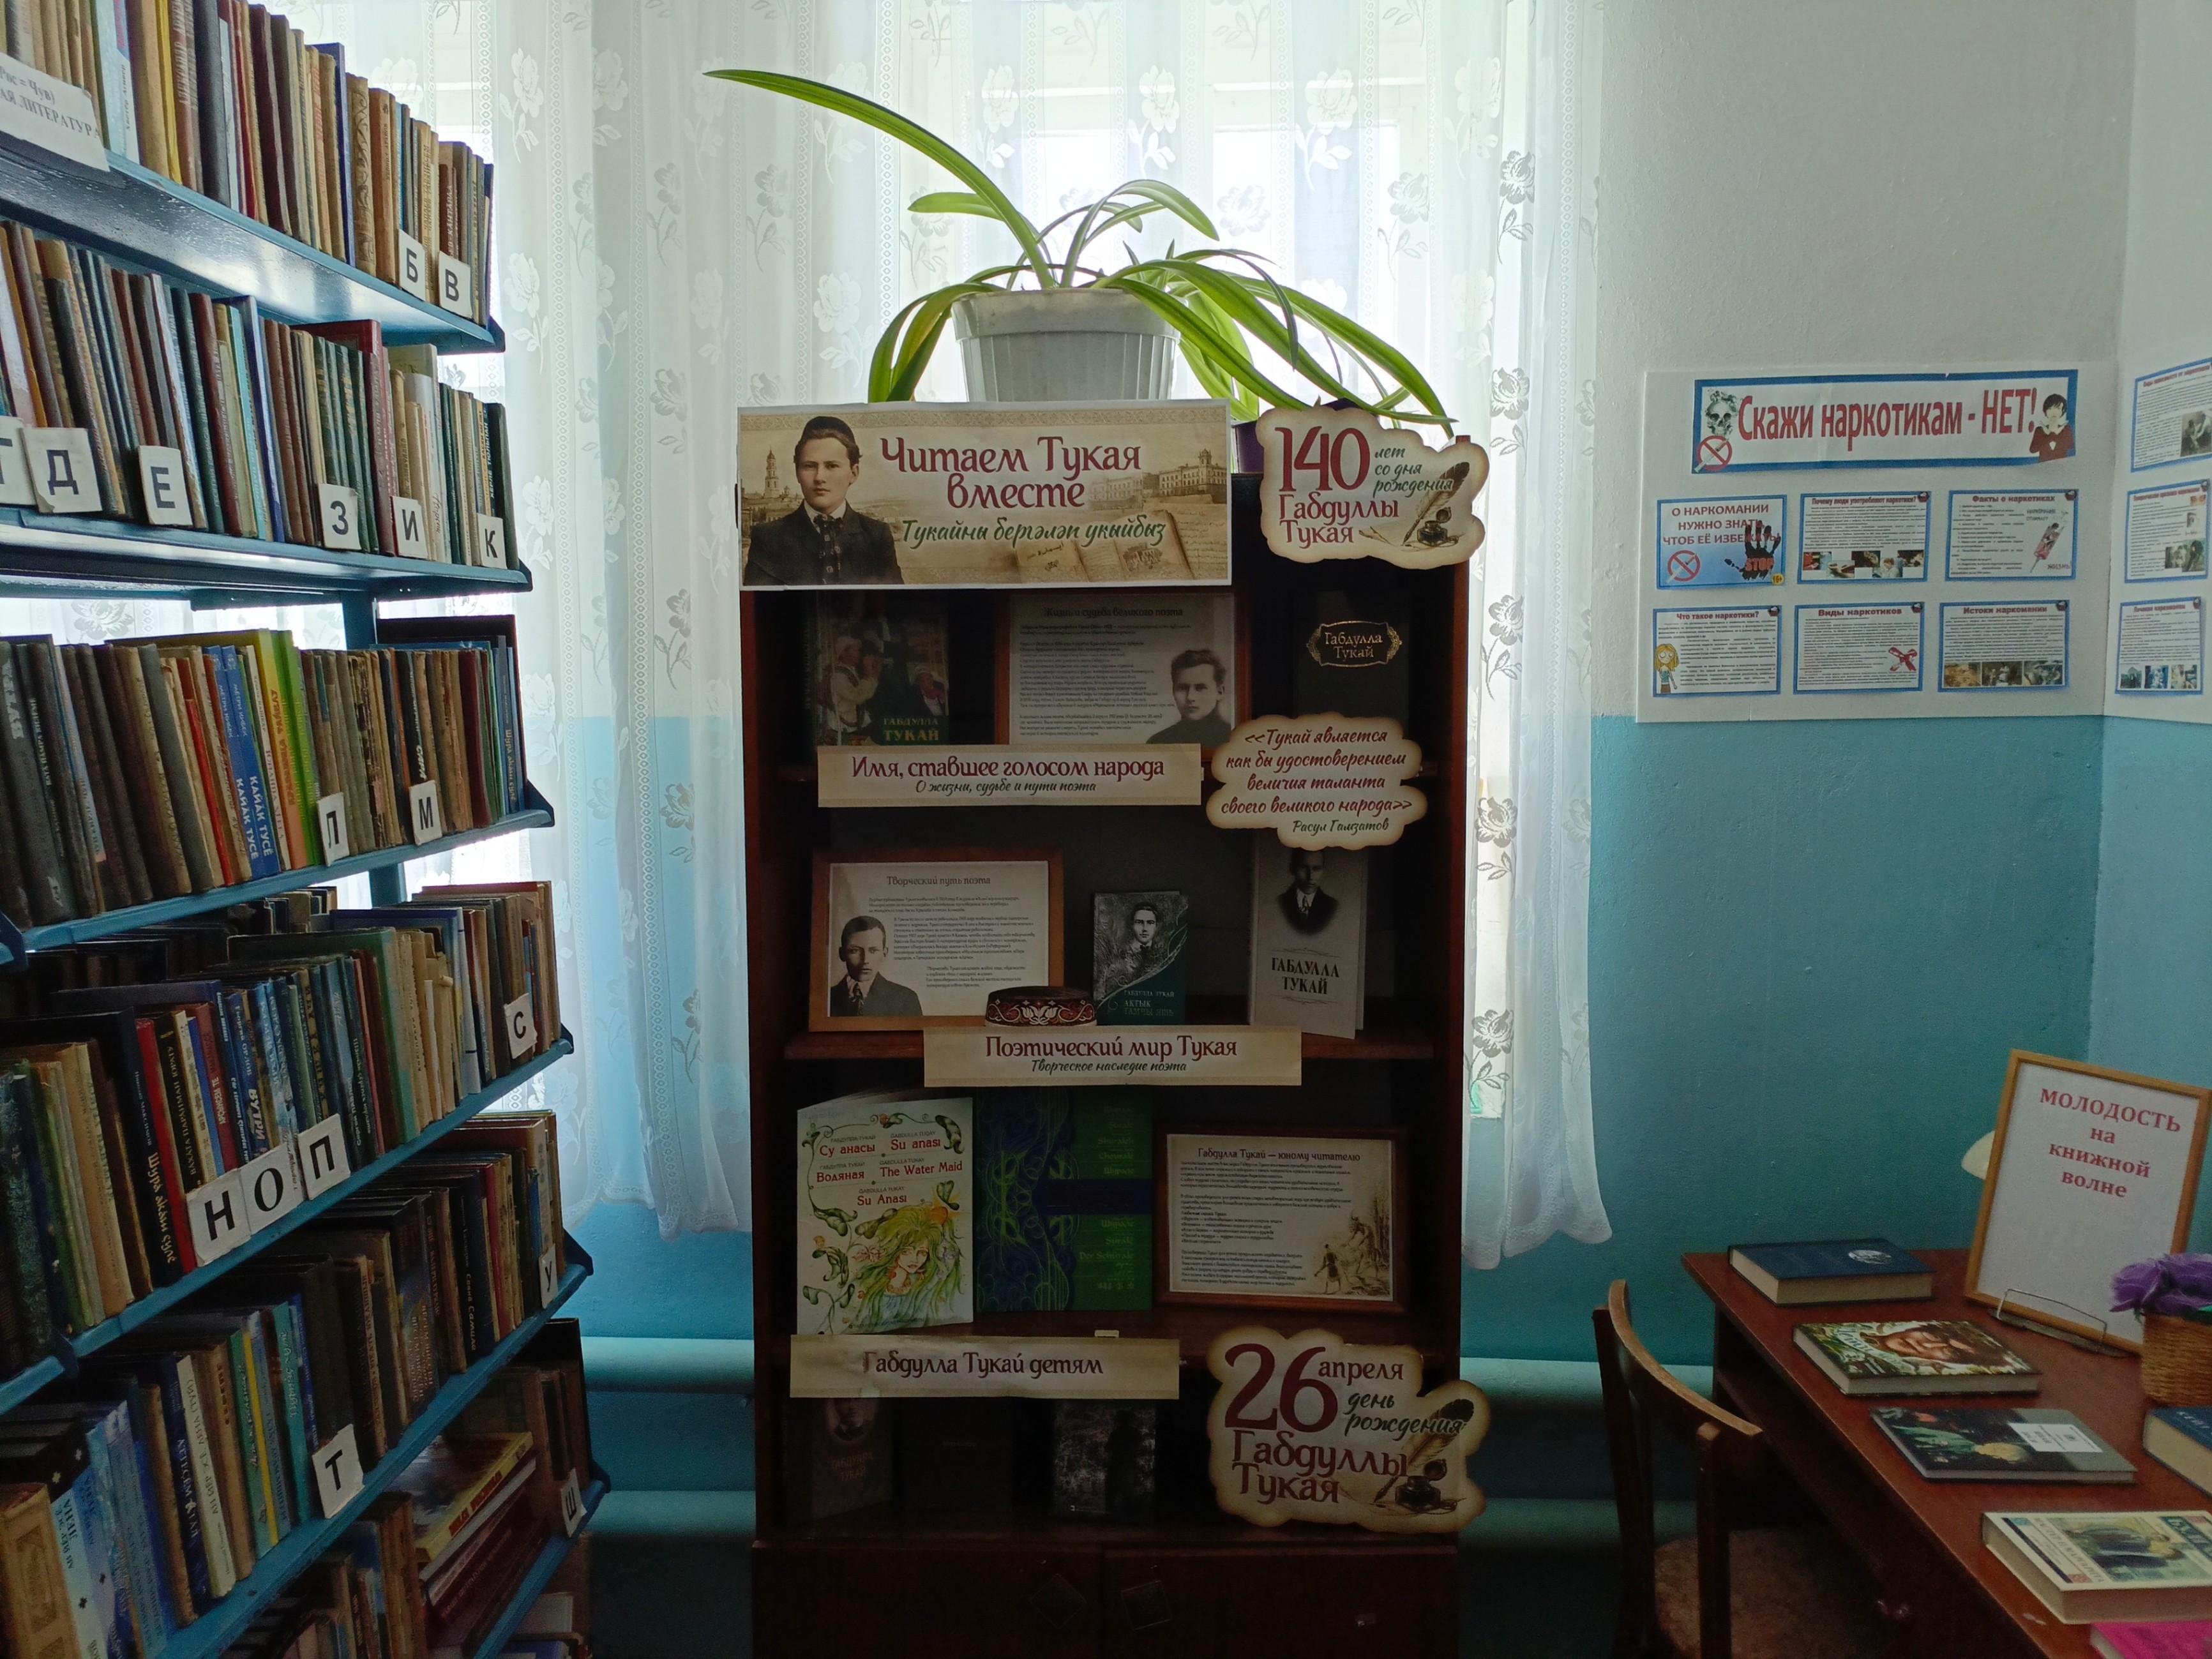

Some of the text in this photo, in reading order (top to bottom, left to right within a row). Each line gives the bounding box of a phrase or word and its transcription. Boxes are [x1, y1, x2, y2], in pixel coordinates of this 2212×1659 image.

[20, 96, 103, 139] ЛИТЕРАТУРА
[406, 248, 419, 282] Б
[446, 269, 458, 302] В
[1738, 394, 1813, 441] Скажи
[1821, 400, 1962, 451] наркотикам
[1982, 387, 2037, 434] НЕТ!
[484, 422, 492, 466] ТЮЛЬПАН
[1374, 447, 1406, 459] лет
[880, 436, 1141, 481] Читаем Тукая
[1275, 426, 1371, 492] 140
[1375, 463, 1422, 480] со дня
[47, 449, 79, 495] Д
[150, 465, 176, 509] Е
[947, 473, 1085, 509] вместе
[1373, 479, 1454, 499] рождения
[2008, 495, 2055, 504] наркотиках
[330, 500, 349, 534] З
[1279, 492, 1400, 525] Габдуллы
[1671, 504, 1769, 516] О НАРКОМАНИИ
[402, 509, 419, 542] И
[902, 520, 987, 550] Тукайны
[1085, 514, 1167, 547] укыйбыз
[1279, 519, 1354, 550] Тукая
[1678, 520, 1721, 530] НУЖНО
[485, 529, 498, 558] К
[1664, 535, 1694, 546] ЧТОБ
[1698, 533, 1711, 544] ЕЁ
[1745, 557, 1775, 571] STOP
[1772, 575, 1783, 583] 16+
[1082, 608, 1111, 619] судьба
[1113, 606, 1154, 617] великого
[1155, 608, 1183, 617] поэта
[1676, 613, 1690, 621] Что
[1715, 611, 1759, 620] наркотики?
[1818, 607, 1902, 618] Виды наркотиков
[1963, 606, 2048, 615] Истоки наркомании
[1324, 631, 1383, 645] Габдулла
[1334, 645, 1374, 661] Тукай
[884, 727, 939, 741] ТУКАЙ
[1314, 726, 1388, 744] является
[852, 756, 1164, 786] Имя, ставшее голосом народа
[1226, 749, 1406, 773] как бы удостоверением
[916, 778, 1096, 797] О жизни, судьбе и пути поэта
[1247, 773, 1385, 791] величия таланта
[250, 776, 265, 821] КАЙӐК
[1221, 796, 1267, 814] своего
[1270, 795, 1334, 813] великого
[419, 797, 434, 830] М
[327, 811, 339, 848] Л
[1293, 818, 1389, 836] Расул Гамзатов
[887, 875, 991, 887] Творческий путь поэта
[1272, 956, 1339, 978] ГАБДУЛЛА
[1282, 976, 1328, 995] ТУКАЙ
[513, 1011, 527, 1039] С
[241, 1042, 253, 1076] ОРЛОВ
[986, 1035, 1237, 1062] Поэтический мир Тукая
[1032, 1060, 1187, 1076] Творческое наследие поэта
[248, 1088, 266, 1140] ВУТРИ
[2039, 1088, 2181, 1134] МОЛОДОСТЬ
[891, 1139, 907, 1151] Su
[2089, 1127, 2116, 1145] на
[820, 1143, 875, 1158] Су анасы
[1198, 1147, 1360, 1162] Габдулла Тукай юному читателю
[2049, 1143, 2151, 1178] книжной
[816, 1170, 864, 1183] Водяная
[880, 1160, 963, 1178] The Water Maid
[204, 1190, 235, 1241] Н
[255, 1168, 284, 1212] О
[309, 1134, 335, 1180] П
[2061, 1171, 2127, 1198] волне
[857, 1196, 871, 1206] Su
[545, 1260, 552, 1293] У
[864, 1349, 1104, 1379] Габдулла Тукай детям
[1318, 1360, 1404, 1385] апреля
[1225, 1343, 1338, 1432] 26
[1343, 1393, 1395, 1415] день
[1344, 1413, 1461, 1441] рождения
[1232, 1430, 1408, 1476] Габдуллы
[325, 1450, 343, 1491] Т
[1232, 1463, 1340, 1504] Тукая
